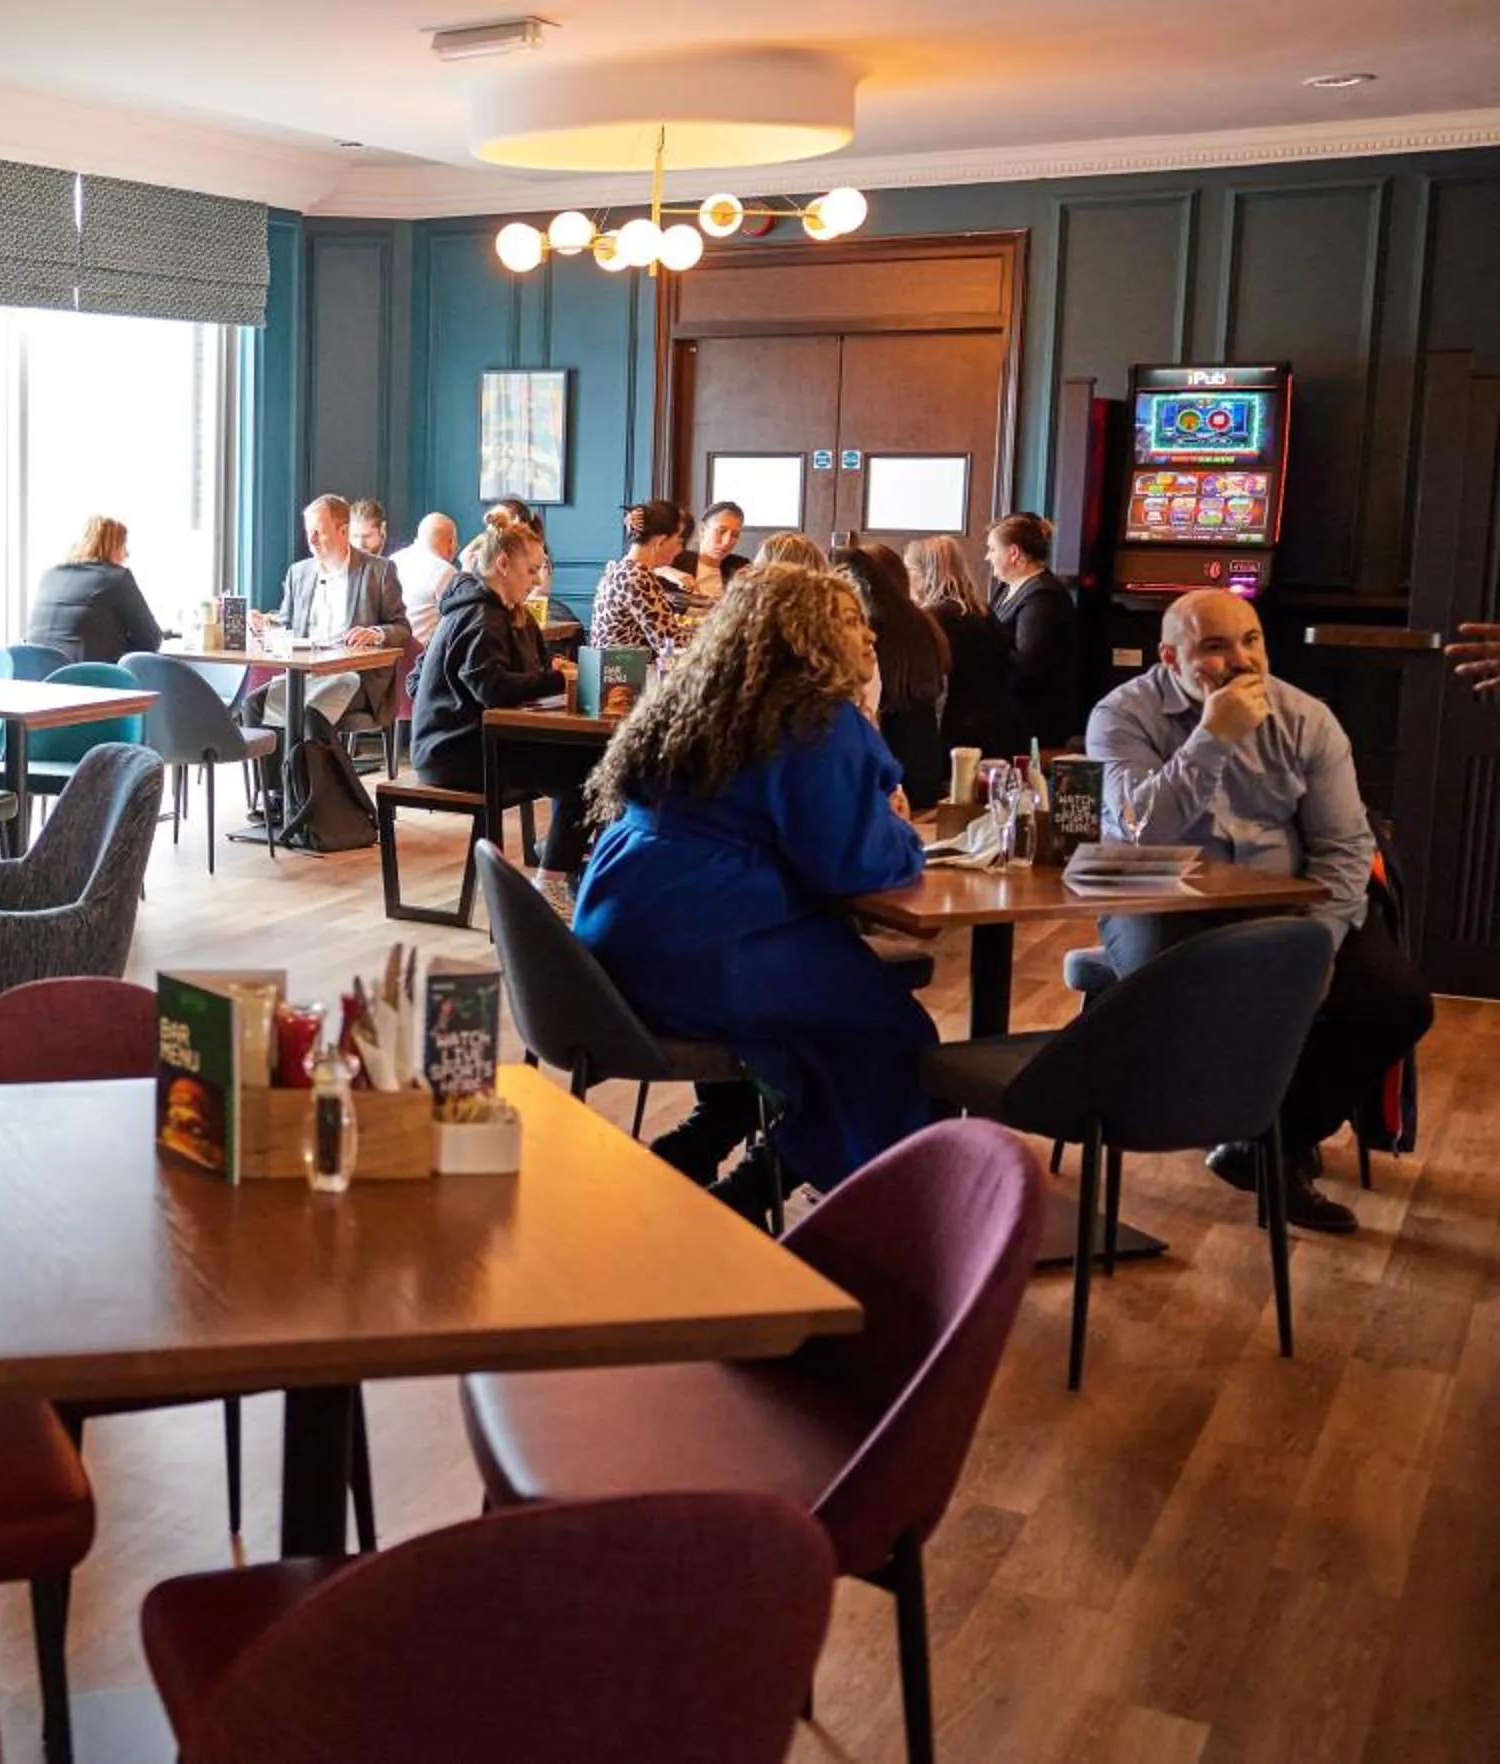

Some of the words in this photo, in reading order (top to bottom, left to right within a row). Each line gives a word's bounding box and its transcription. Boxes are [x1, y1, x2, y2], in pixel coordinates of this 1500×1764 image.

[1059, 795, 1097, 805] WATCH
[160, 1016, 190, 1045] BAR
[436, 1030, 491, 1048] WATCH
[160, 1041, 201, 1072] MENU
[430, 1061, 493, 1081] SPORTS
